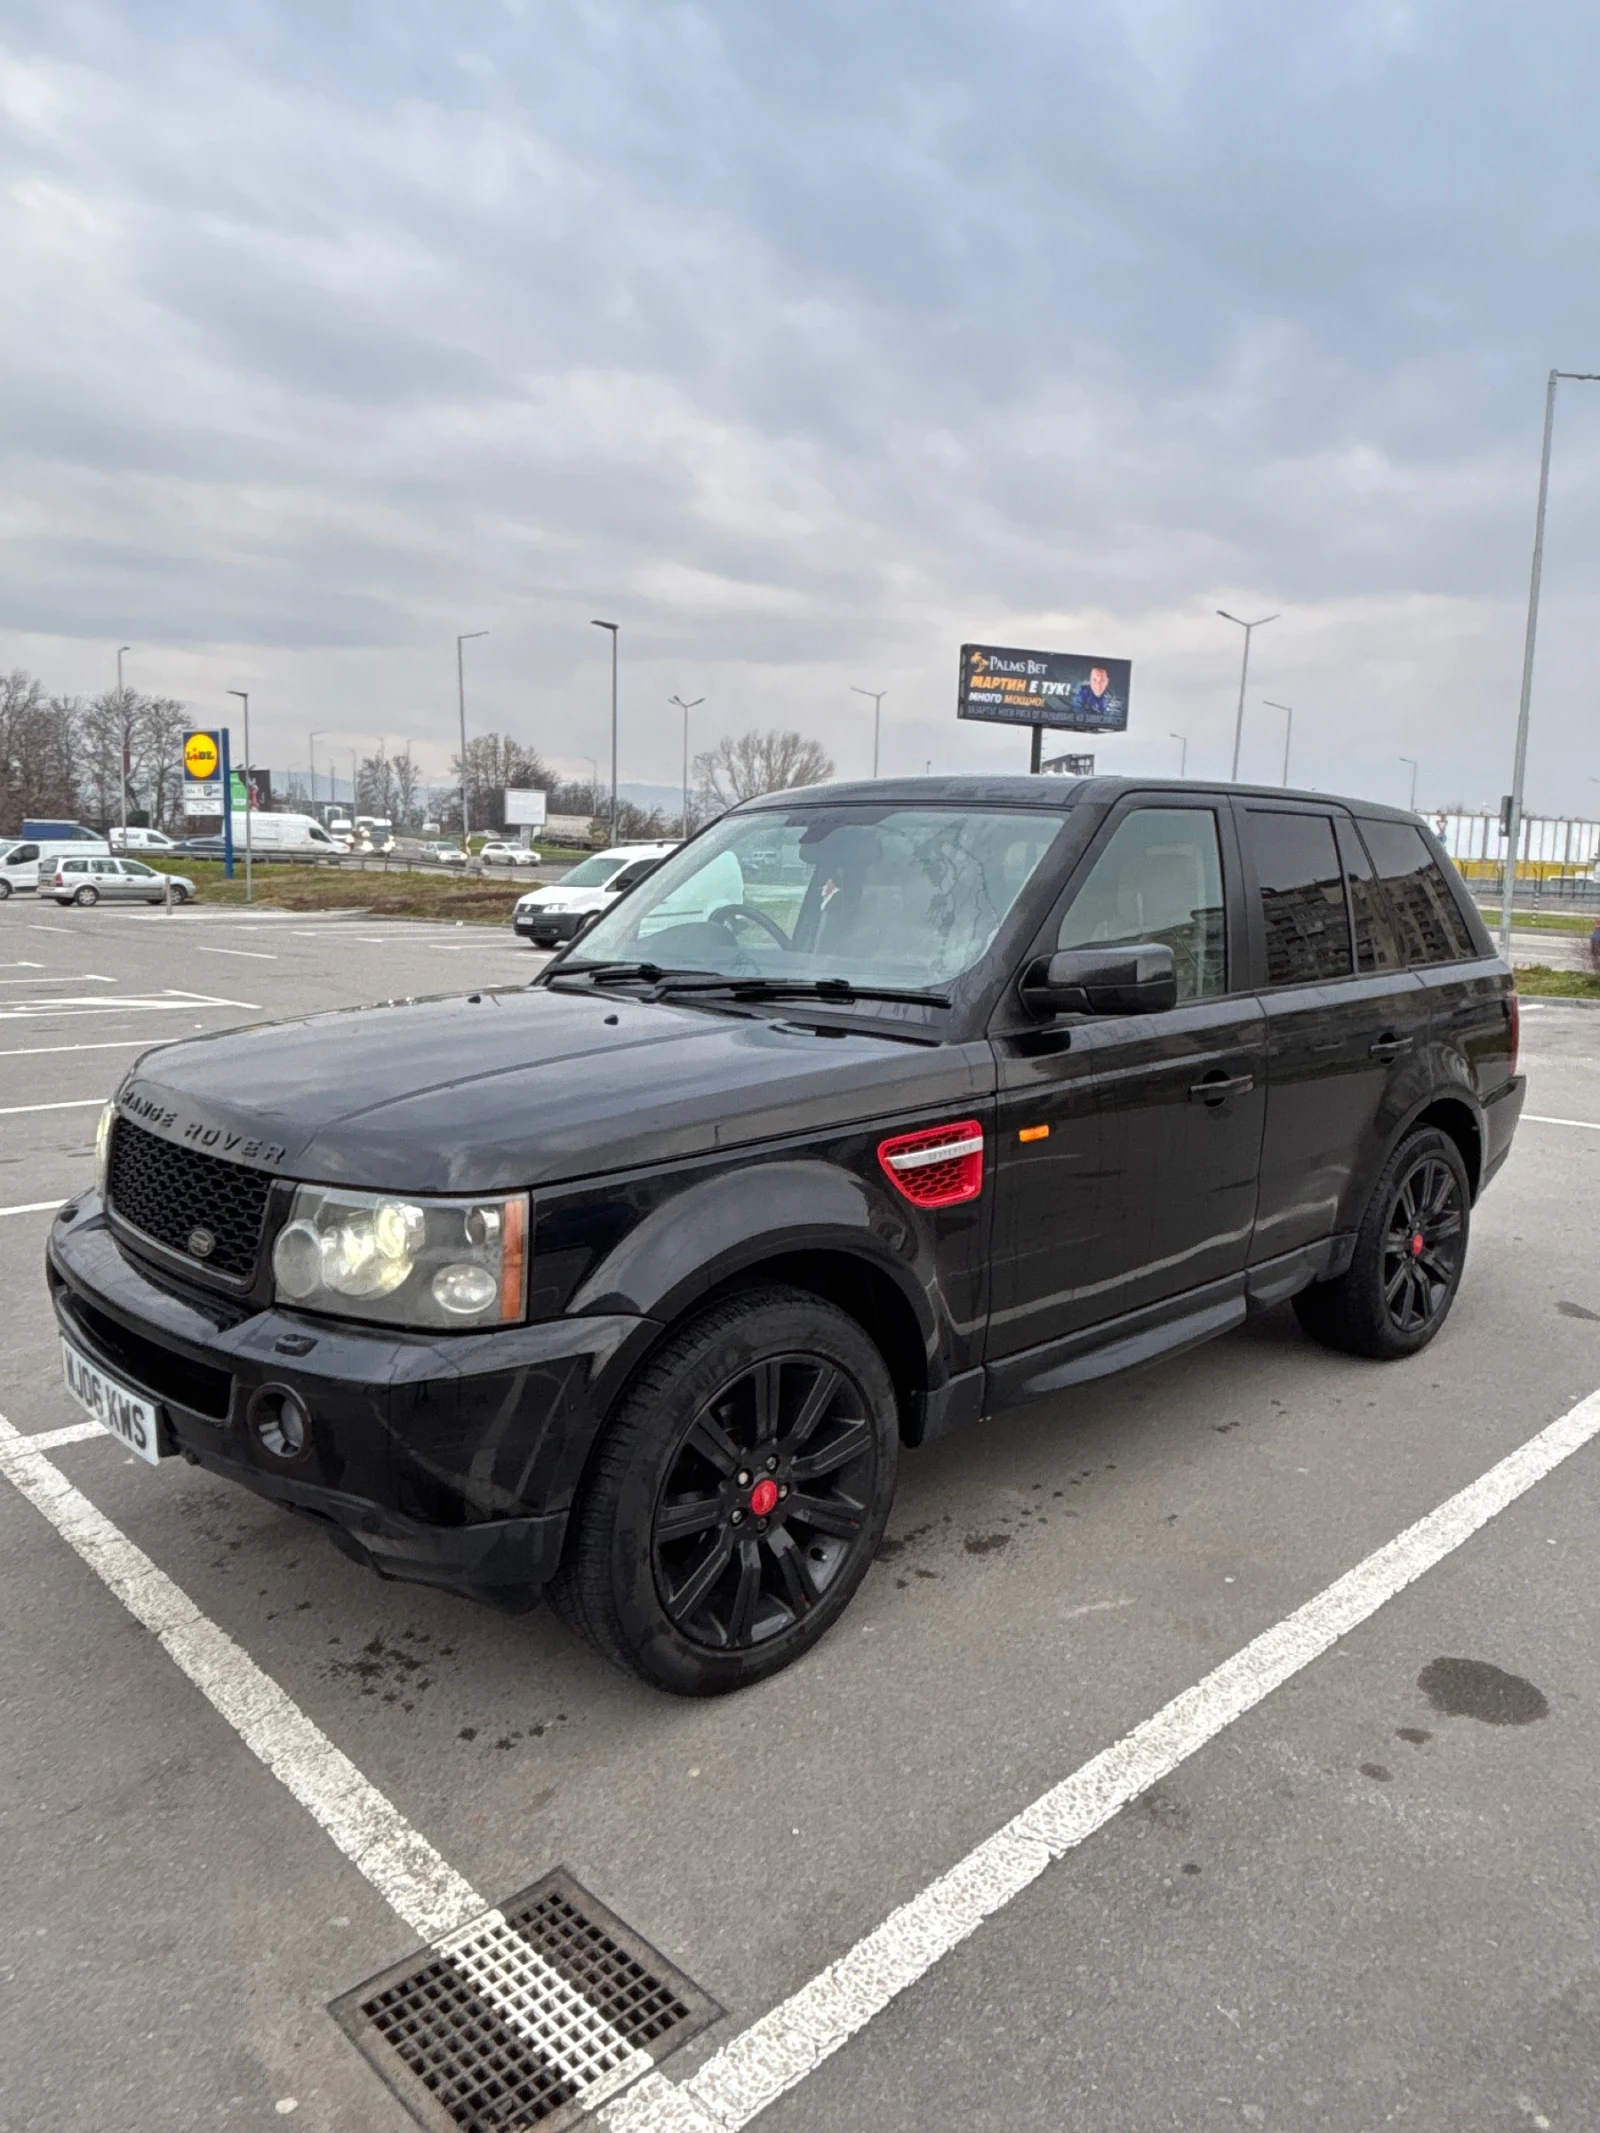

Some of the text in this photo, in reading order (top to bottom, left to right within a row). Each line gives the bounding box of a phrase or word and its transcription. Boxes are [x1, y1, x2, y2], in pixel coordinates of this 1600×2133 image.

[989, 655, 1048, 675] PALMS BET
[970, 675, 1027, 692] МАРТИН
[1041, 681, 1072, 696] ТУК!
[968, 691, 1003, 704] МНОГО
[121, 1091, 286, 1165] RANGE ROVER
